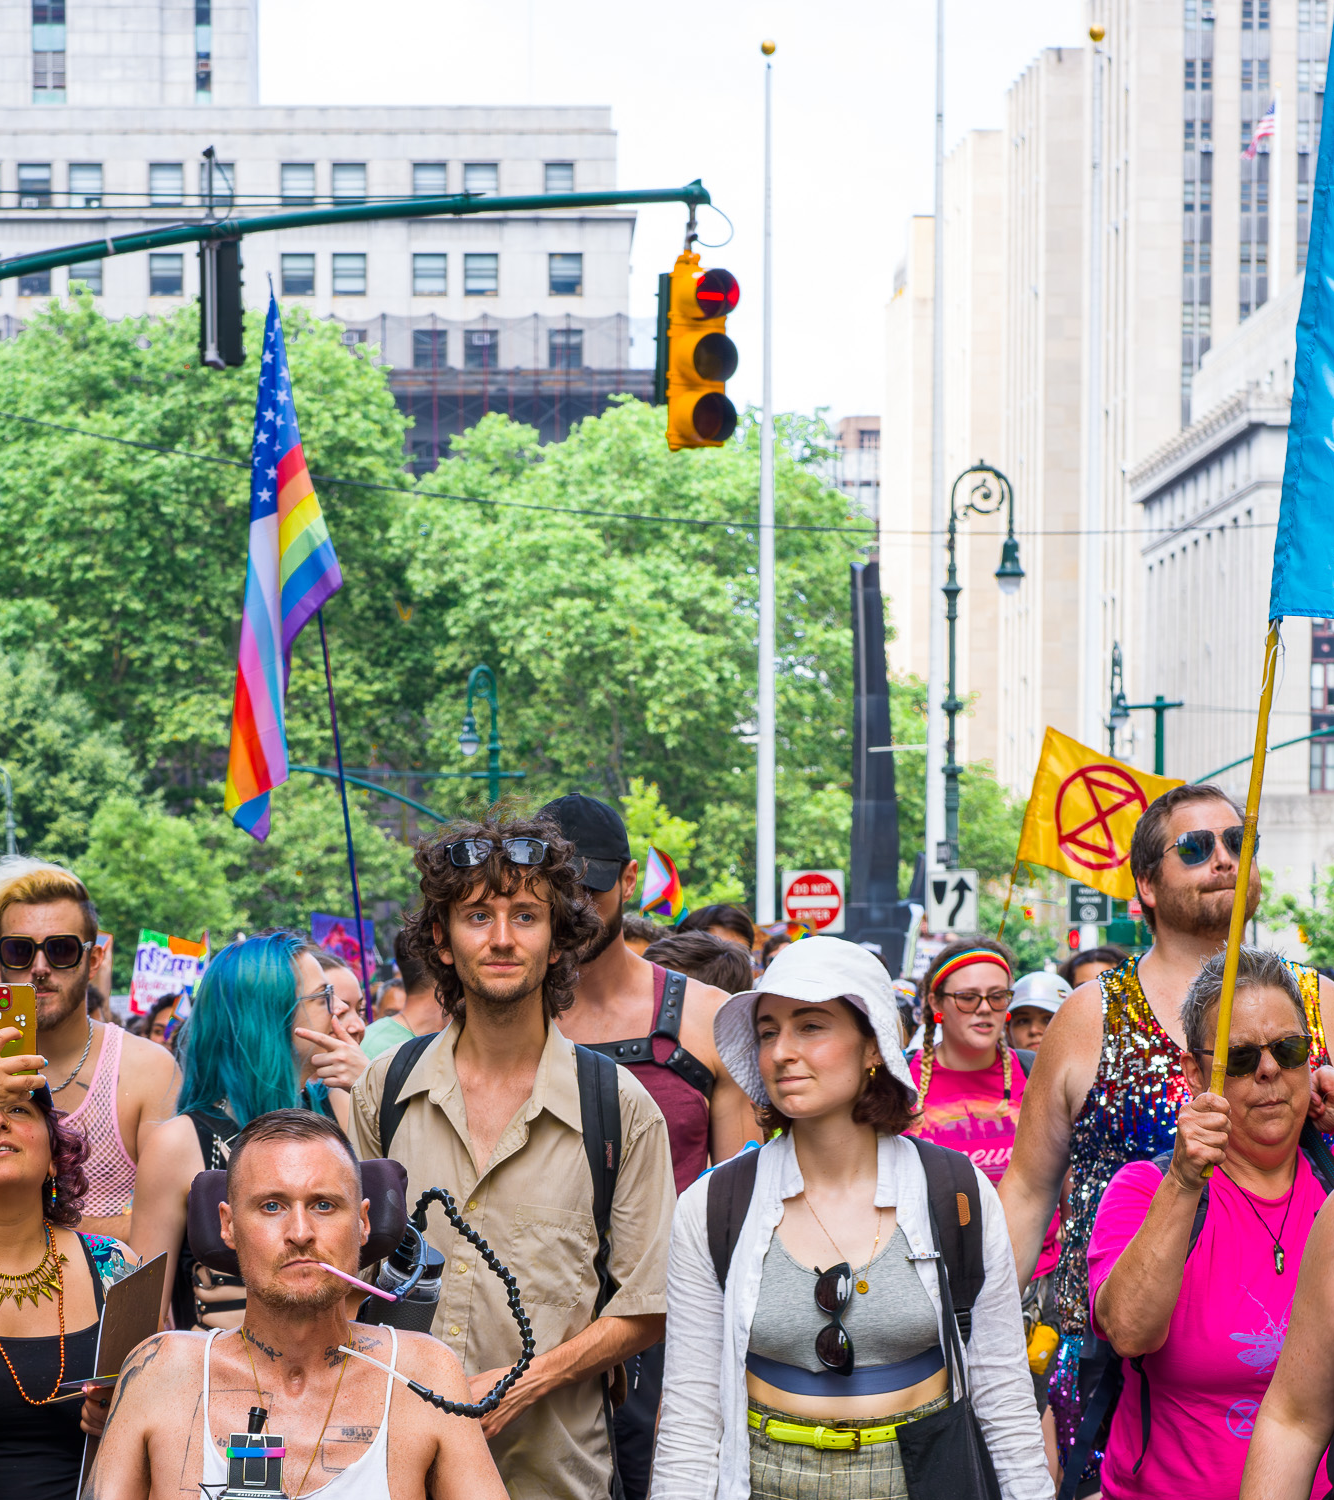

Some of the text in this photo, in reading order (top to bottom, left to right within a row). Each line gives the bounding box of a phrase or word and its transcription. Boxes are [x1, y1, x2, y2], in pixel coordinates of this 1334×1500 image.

[793, 882, 832, 895] DO NOT
[341, 1427, 373, 1438] HELLO
